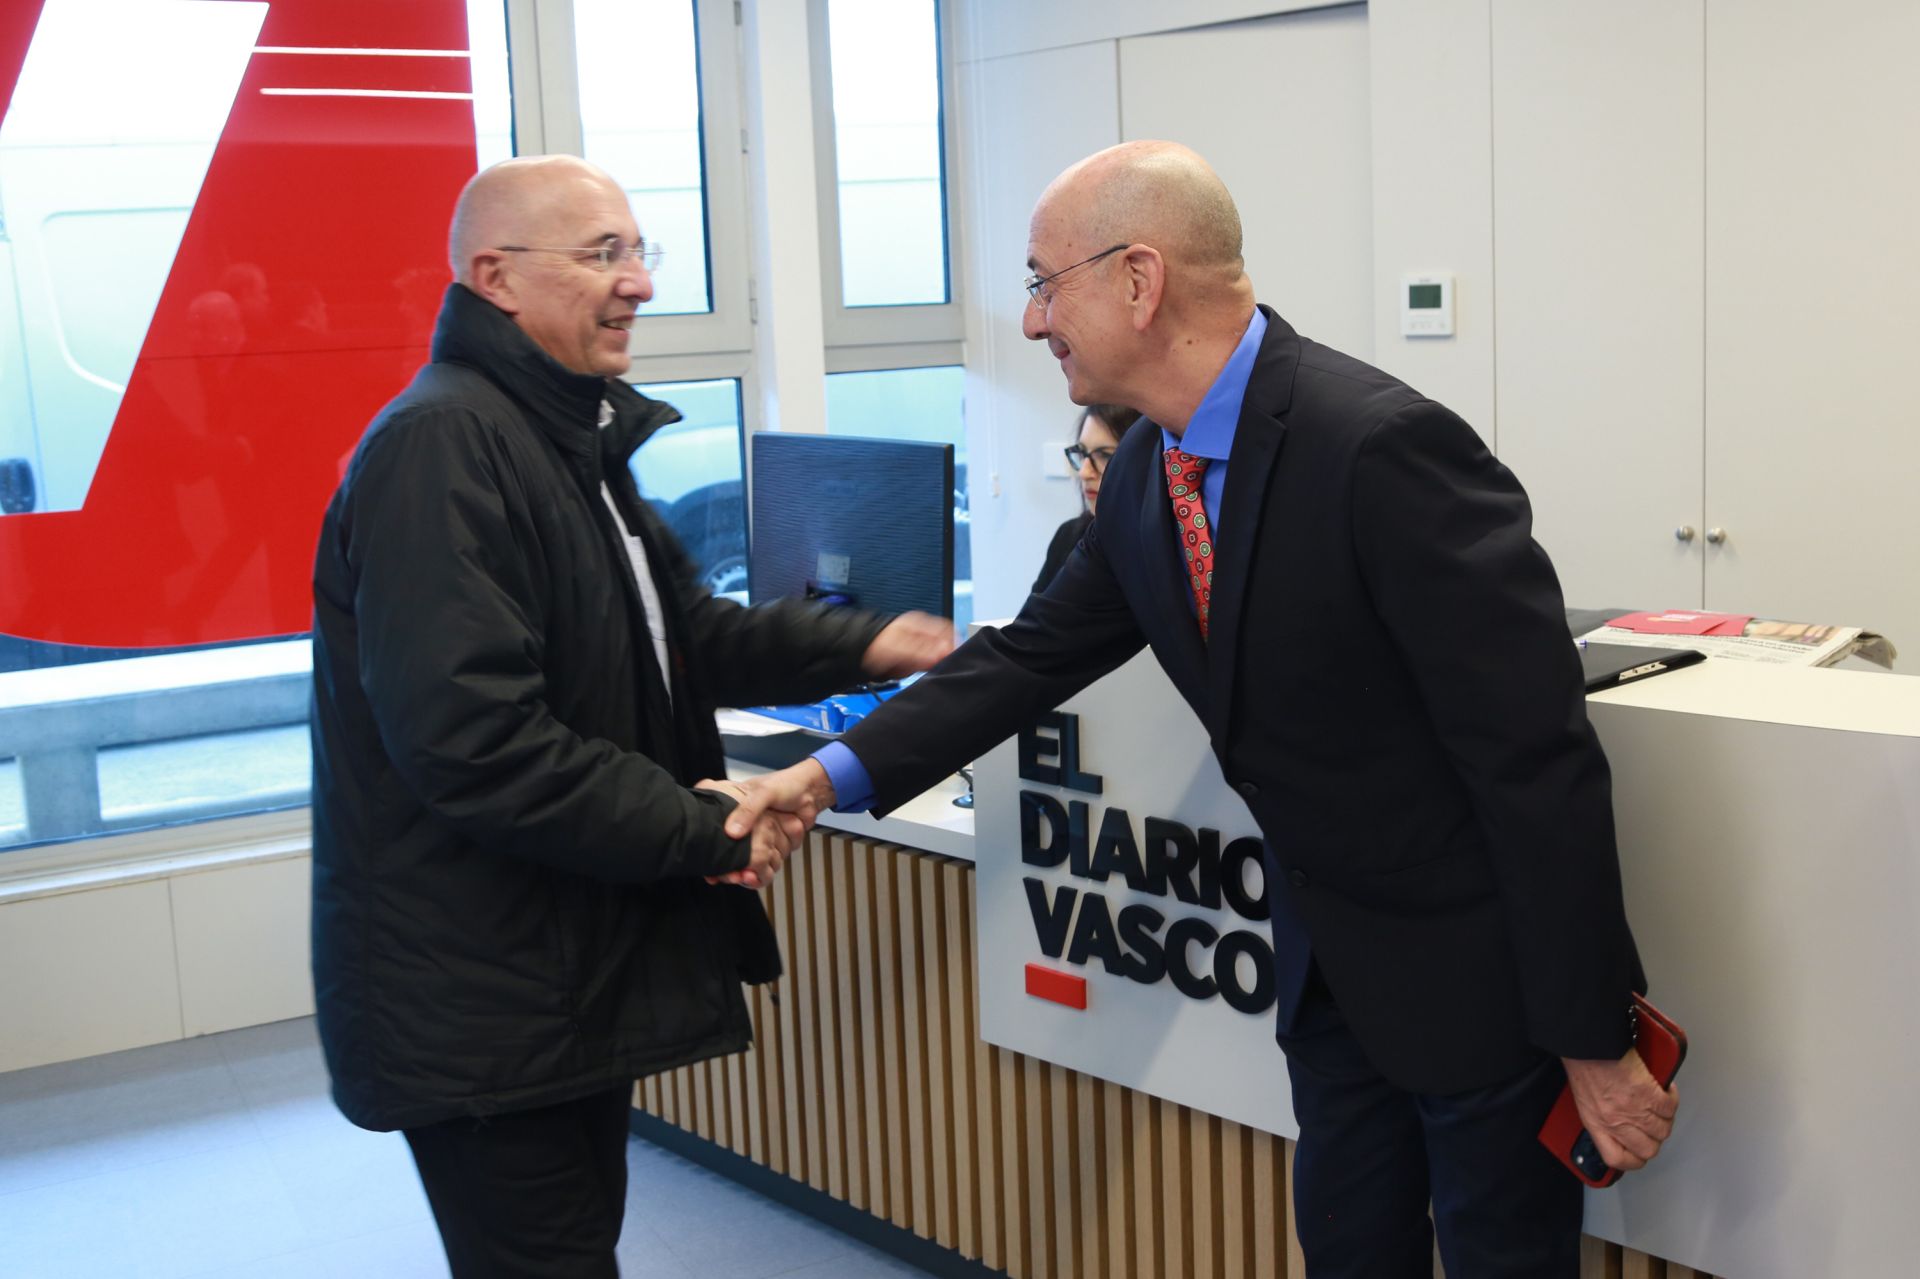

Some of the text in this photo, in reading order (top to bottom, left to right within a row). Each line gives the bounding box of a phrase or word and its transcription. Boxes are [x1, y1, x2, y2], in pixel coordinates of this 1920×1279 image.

[1018, 710, 1103, 794] EL
[1020, 789, 1271, 921] DIARIO
[1022, 876, 1278, 1014] VASCO
